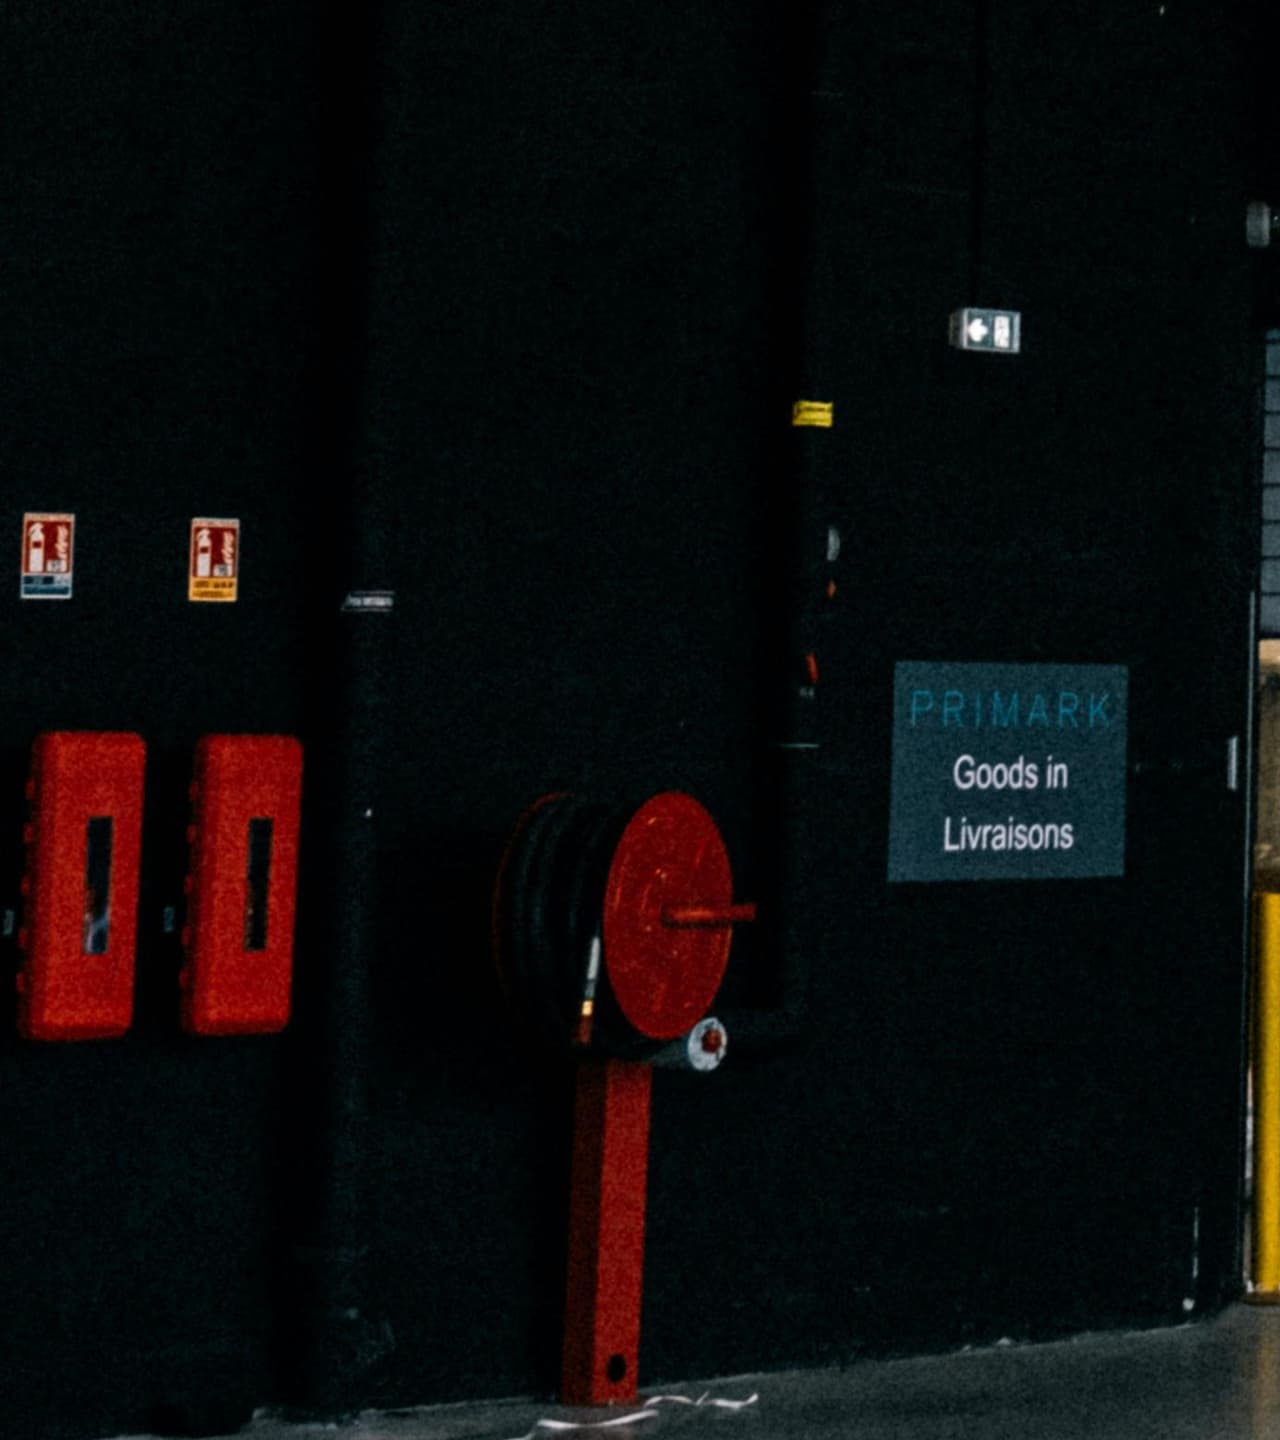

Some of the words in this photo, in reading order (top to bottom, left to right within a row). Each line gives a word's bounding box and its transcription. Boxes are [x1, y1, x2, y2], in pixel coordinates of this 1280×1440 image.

[910, 690, 1113, 727] PRIMARK
[953, 754, 1039, 789] Goods
[1046, 755, 1068, 789] in
[944, 817, 1074, 851] Livraisons
